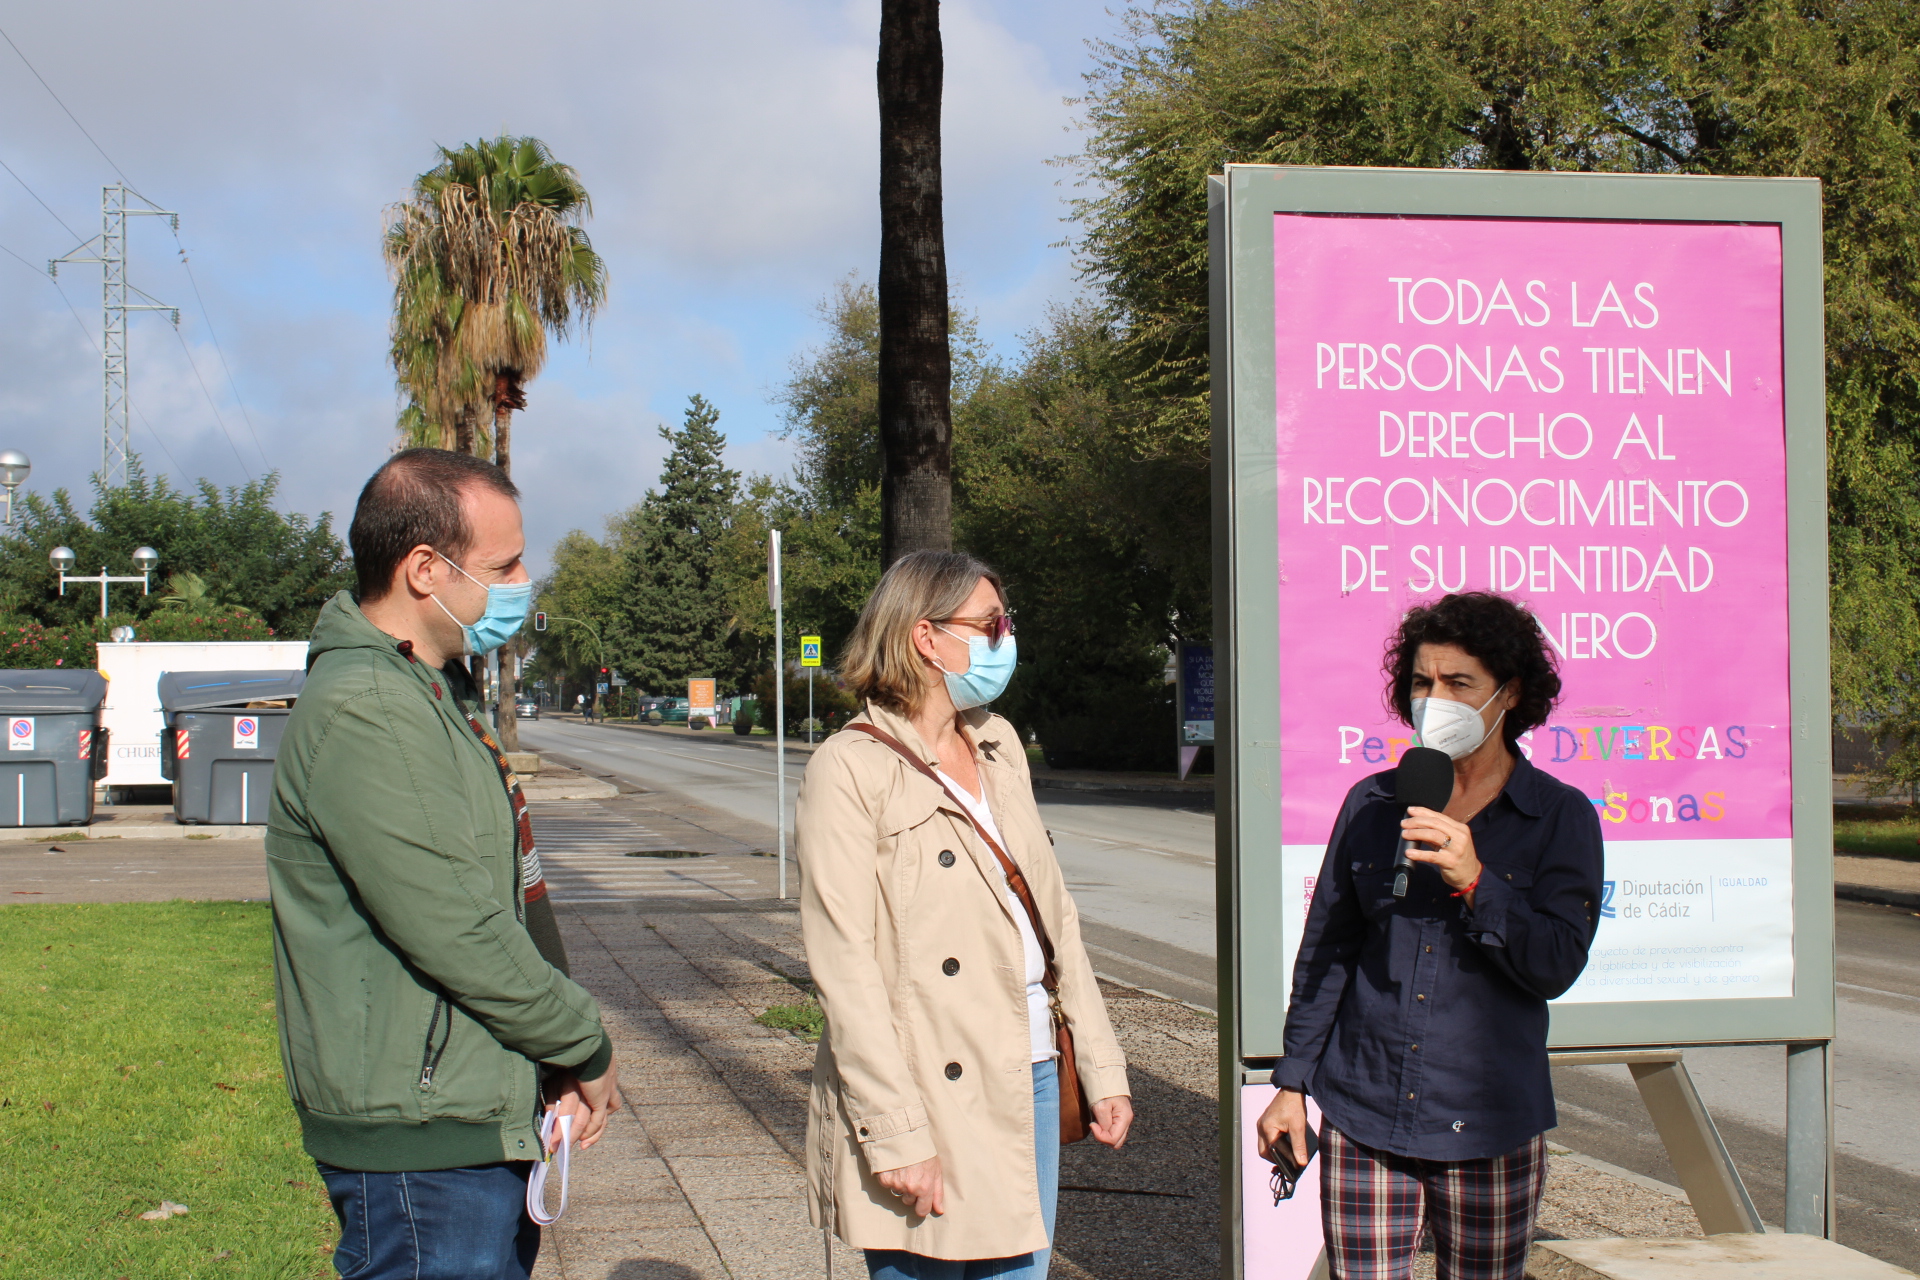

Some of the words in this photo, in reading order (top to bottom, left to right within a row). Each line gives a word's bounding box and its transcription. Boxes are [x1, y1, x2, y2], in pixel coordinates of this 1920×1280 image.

[1388, 277, 1551, 327] TODAS
[1571, 280, 1659, 329] LAS
[1316, 342, 1565, 394] PERSONAS
[1582, 346, 1732, 397] TIENEN
[1379, 410, 1593, 460] DERECHO
[1612, 412, 1676, 461] AL
[1303, 476, 1749, 528] RECONOCIMIENTO
[1341, 544, 1389, 593] DE
[1408, 544, 1467, 593] SU
[1489, 543, 1714, 594] IDENTIDAD
[1516, 601, 1657, 661] NERO
[1550, 726, 1746, 762] DIVERSAS
[1623, 879, 1704, 898] Diputación
[1718, 877, 1768, 887] IGUALDAD
[1623, 903, 1642, 918] de
[1648, 902, 1691, 918] Cádiz
[1589, 947, 1629, 959] royecto
[1632, 945, 1646, 956] de
[1649, 944, 1707, 957] prevención
[1710, 943, 1744, 954] contra
[1599, 959, 1648, 973] lgbtifobia
[1651, 962, 1658, 971] y
[1661, 957, 1675, 969] de
[1679, 957, 1742, 968] visibilización
[1585, 974, 1596, 986] la
[1599, 973, 1653, 986] diversidad
[1657, 972, 1690, 984] sexual
[1693, 976, 1701, 986] y
[1704, 972, 1718, 983] de
[1722, 973, 1760, 986] género
